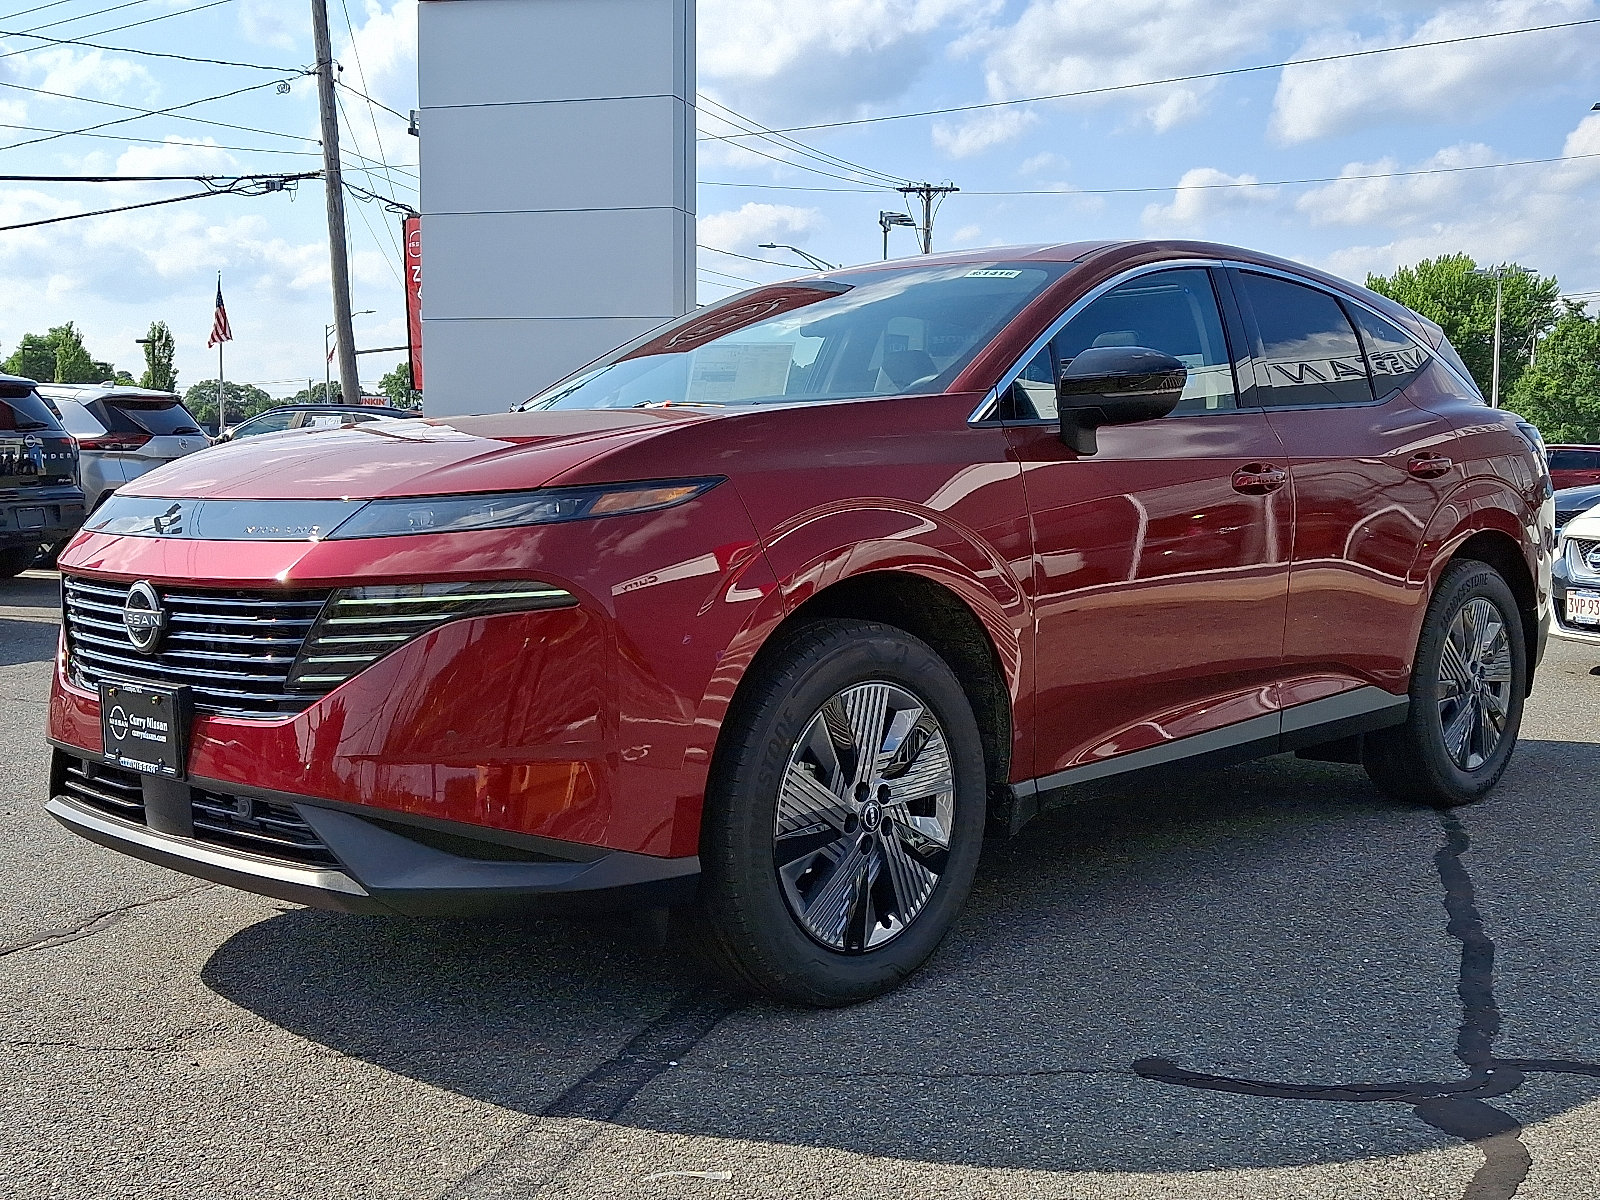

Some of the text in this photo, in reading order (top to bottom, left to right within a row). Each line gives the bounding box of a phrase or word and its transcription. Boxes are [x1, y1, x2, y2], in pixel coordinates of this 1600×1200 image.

[1, 453, 72, 461] THFINDER
[127, 613, 160, 626] SSAN
[129, 713, 168, 731] Curry Nissan
